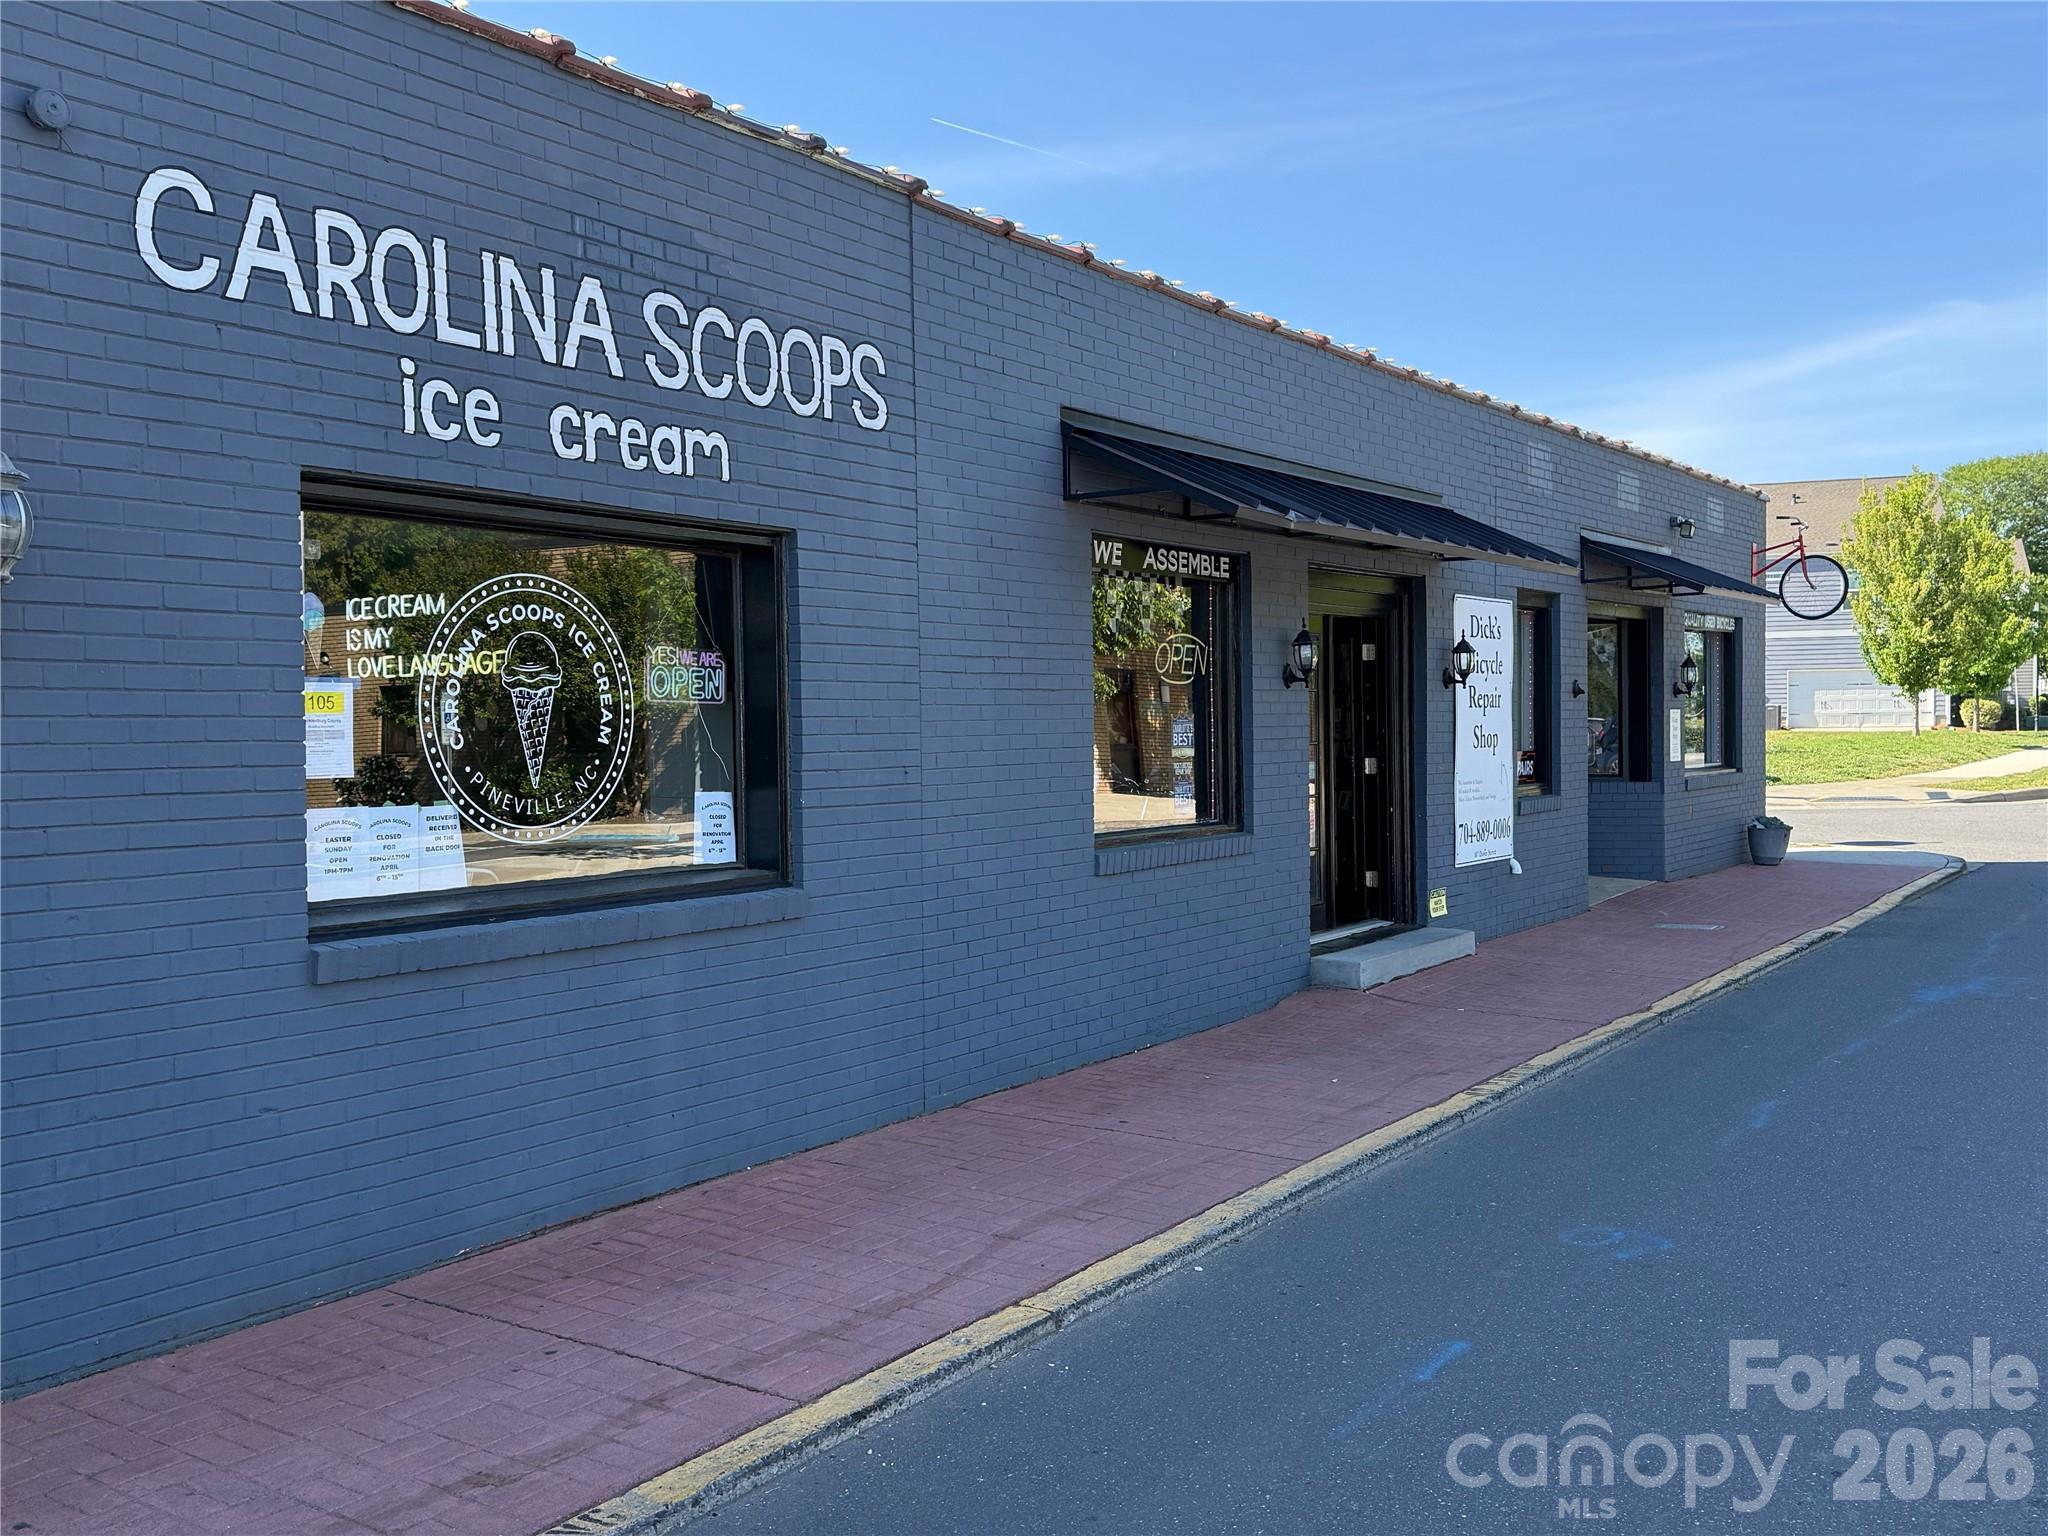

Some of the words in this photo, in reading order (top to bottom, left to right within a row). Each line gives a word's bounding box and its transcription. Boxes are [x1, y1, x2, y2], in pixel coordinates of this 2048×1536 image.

[134, 166, 624, 379] CAROLINA
[643, 290, 889, 432] SCOOPS
[400, 357, 504, 449] ice
[549, 402, 732, 484] cream
[1093, 539, 1123, 566] WE
[1142, 547, 1230, 579] ASSEMBLE
[1470, 614, 1502, 640] Dick's
[647, 645, 679, 667] YES!
[680, 650, 698, 666] WE
[699, 652, 722, 667] ARE
[1155, 642, 1208, 676] OPEN
[486, 603, 566, 632] SCOOPS
[567, 623, 596, 659] ICE
[592, 661, 613, 746] CREAM
[650, 665, 722, 700] OPEN
[308, 695, 335, 710] 105
[1468, 685, 1502, 716] Repair
[1173, 733, 1193, 746] BEST
[1473, 724, 1499, 756] Shop
[469, 771, 572, 815] PINEVILLE,
[574, 765, 597, 795] NC
[325, 836, 352, 844] EASTER
[376, 833, 402, 841] CLOSED
[1458, 815, 1511, 846] 704-889-0006
